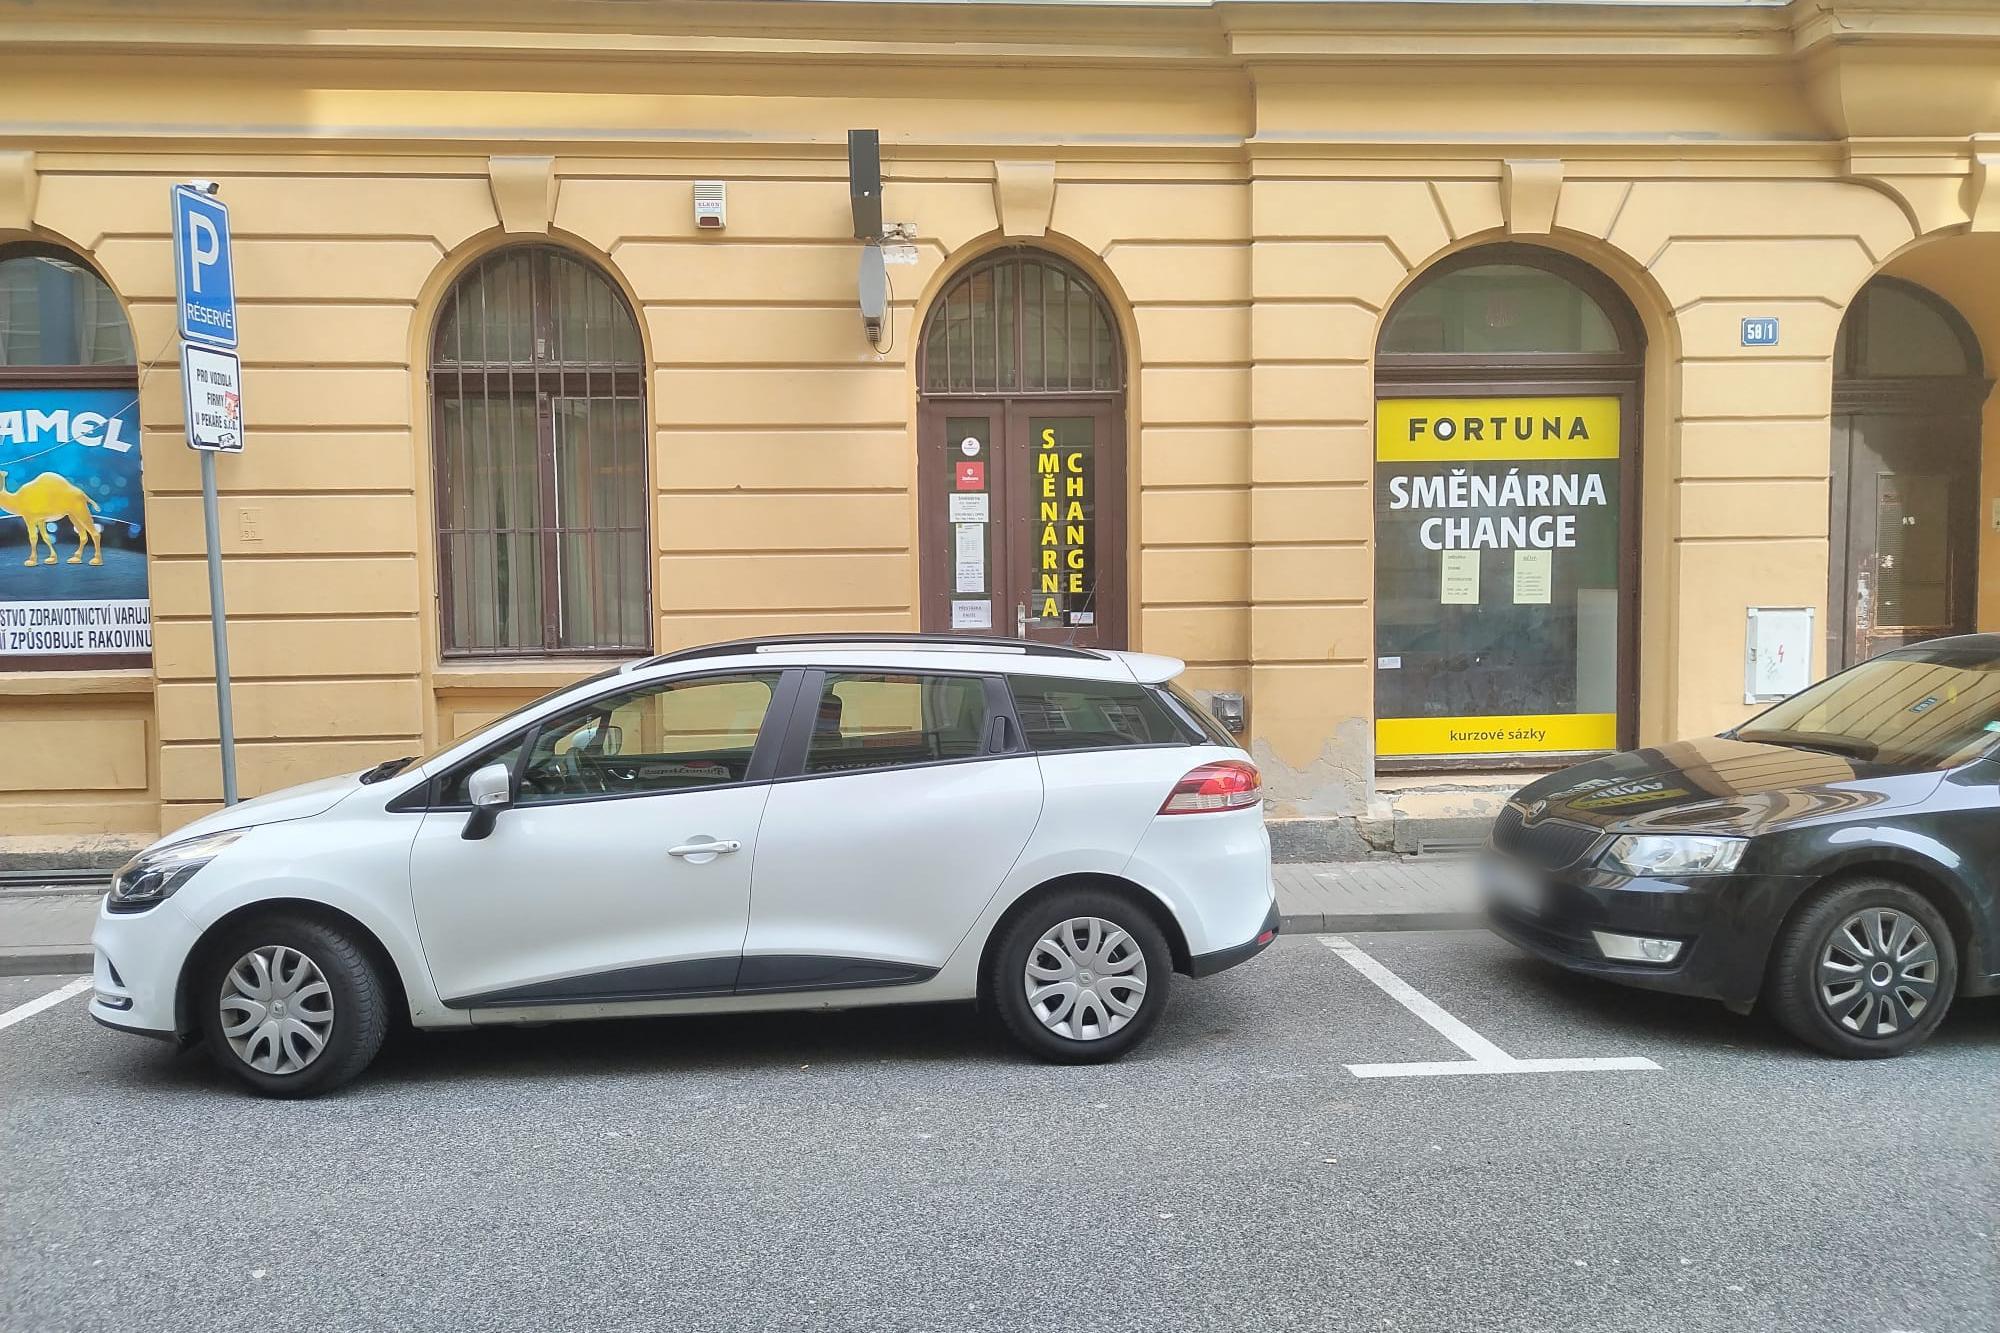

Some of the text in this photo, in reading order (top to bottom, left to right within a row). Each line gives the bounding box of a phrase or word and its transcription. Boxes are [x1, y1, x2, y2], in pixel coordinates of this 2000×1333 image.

[189, 210, 219, 294] P
[187, 301, 233, 329] RÉSERVÉ
[1747, 322, 1773, 340] 58/1
[196, 368, 232, 387] PRO VOZIDLA
[207, 392, 224, 408] FIRMY
[1409, 416, 1590, 441] FORTUNA
[1389, 468, 1607, 509] SMĚNÁRNA
[1038, 429, 1060, 617] SMĚNÁRNA
[1066, 452, 1084, 593] CHANGE
[1420, 515, 1577, 550] CHANGE
[29, 604, 112, 626] ZDRAVOTNICTVÍ
[10, 628, 84, 649] ZPŮSOBUJE
[1450, 728, 1546, 742] kurzové sázky
